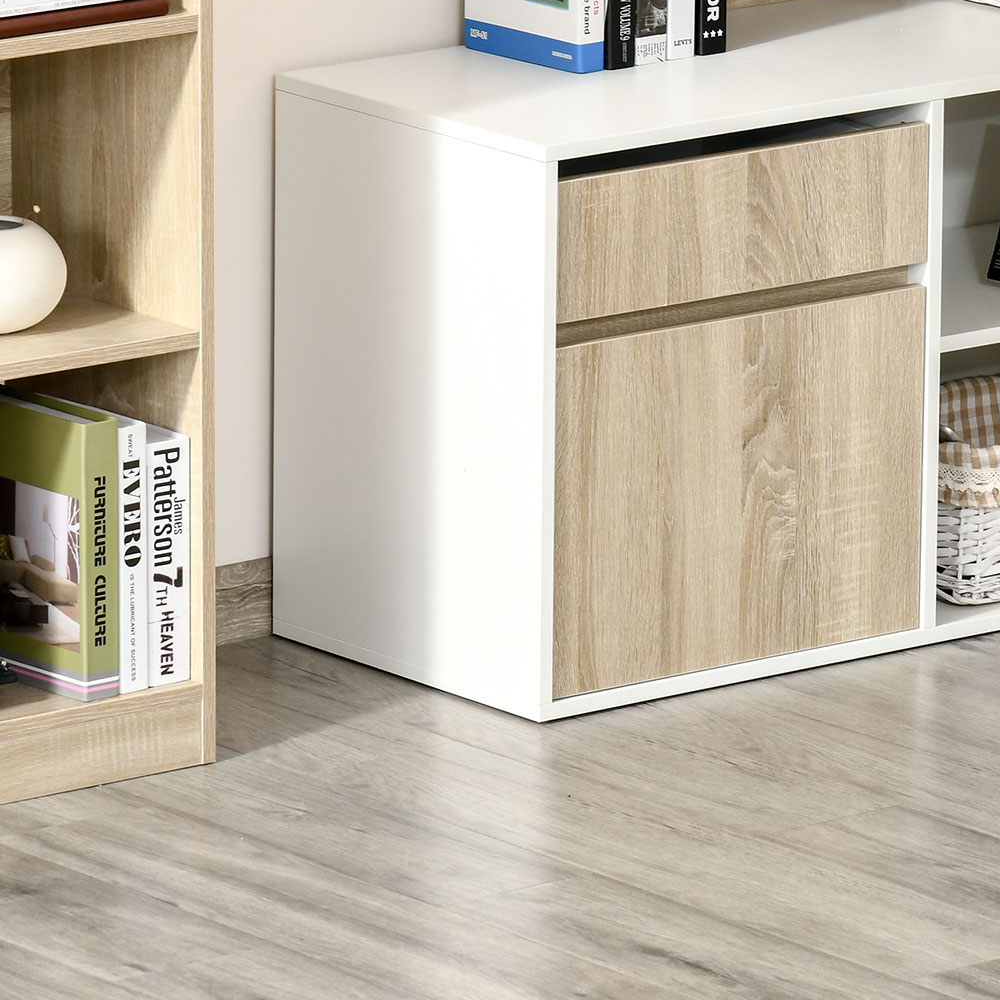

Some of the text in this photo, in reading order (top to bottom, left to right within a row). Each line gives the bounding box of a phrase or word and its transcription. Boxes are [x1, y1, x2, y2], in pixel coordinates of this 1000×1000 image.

[620, 4, 630, 36] VOLUME
[122, 458, 142, 568] EVERO
[153, 447, 180, 567] Patterson
[174, 498, 186, 534] James
[94, 476, 106, 647] FURNITURE CULTURE
[131, 638, 136, 646] OF
[161, 611, 174, 676] HEAVEN
